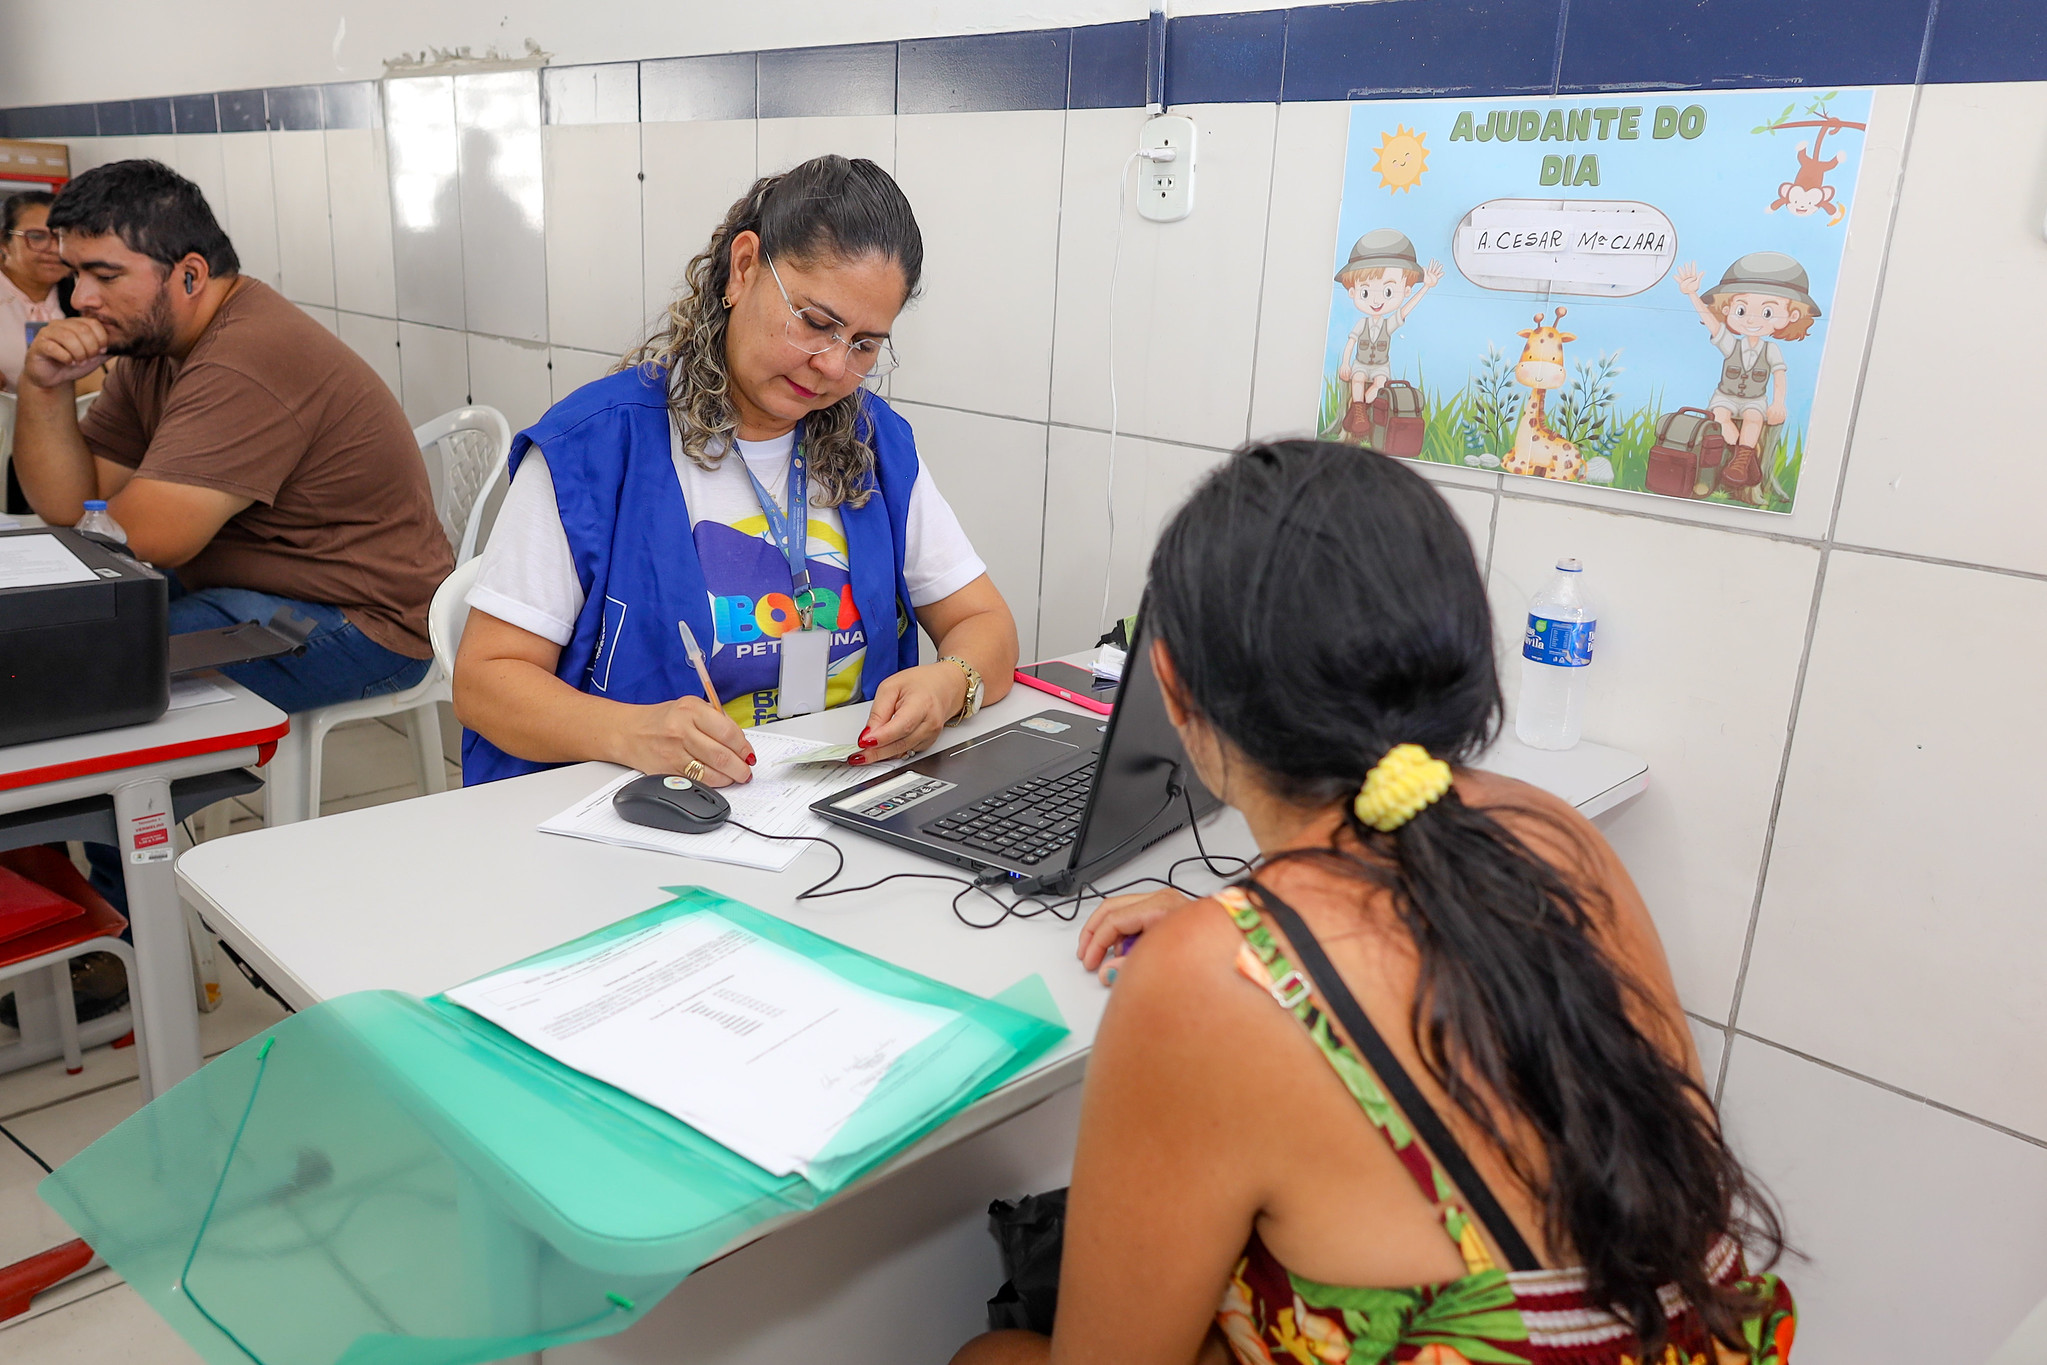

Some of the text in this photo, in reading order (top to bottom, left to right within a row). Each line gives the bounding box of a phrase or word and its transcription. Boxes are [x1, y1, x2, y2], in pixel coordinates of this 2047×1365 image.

[1449, 104, 1707, 142] AJUDANTE DO
[1539, 154, 1601, 186] DIA
[1496, 230, 1563, 249] CESAR
[1610, 232, 1666, 252] CLARA
[736, 630, 865, 659] PETINA
